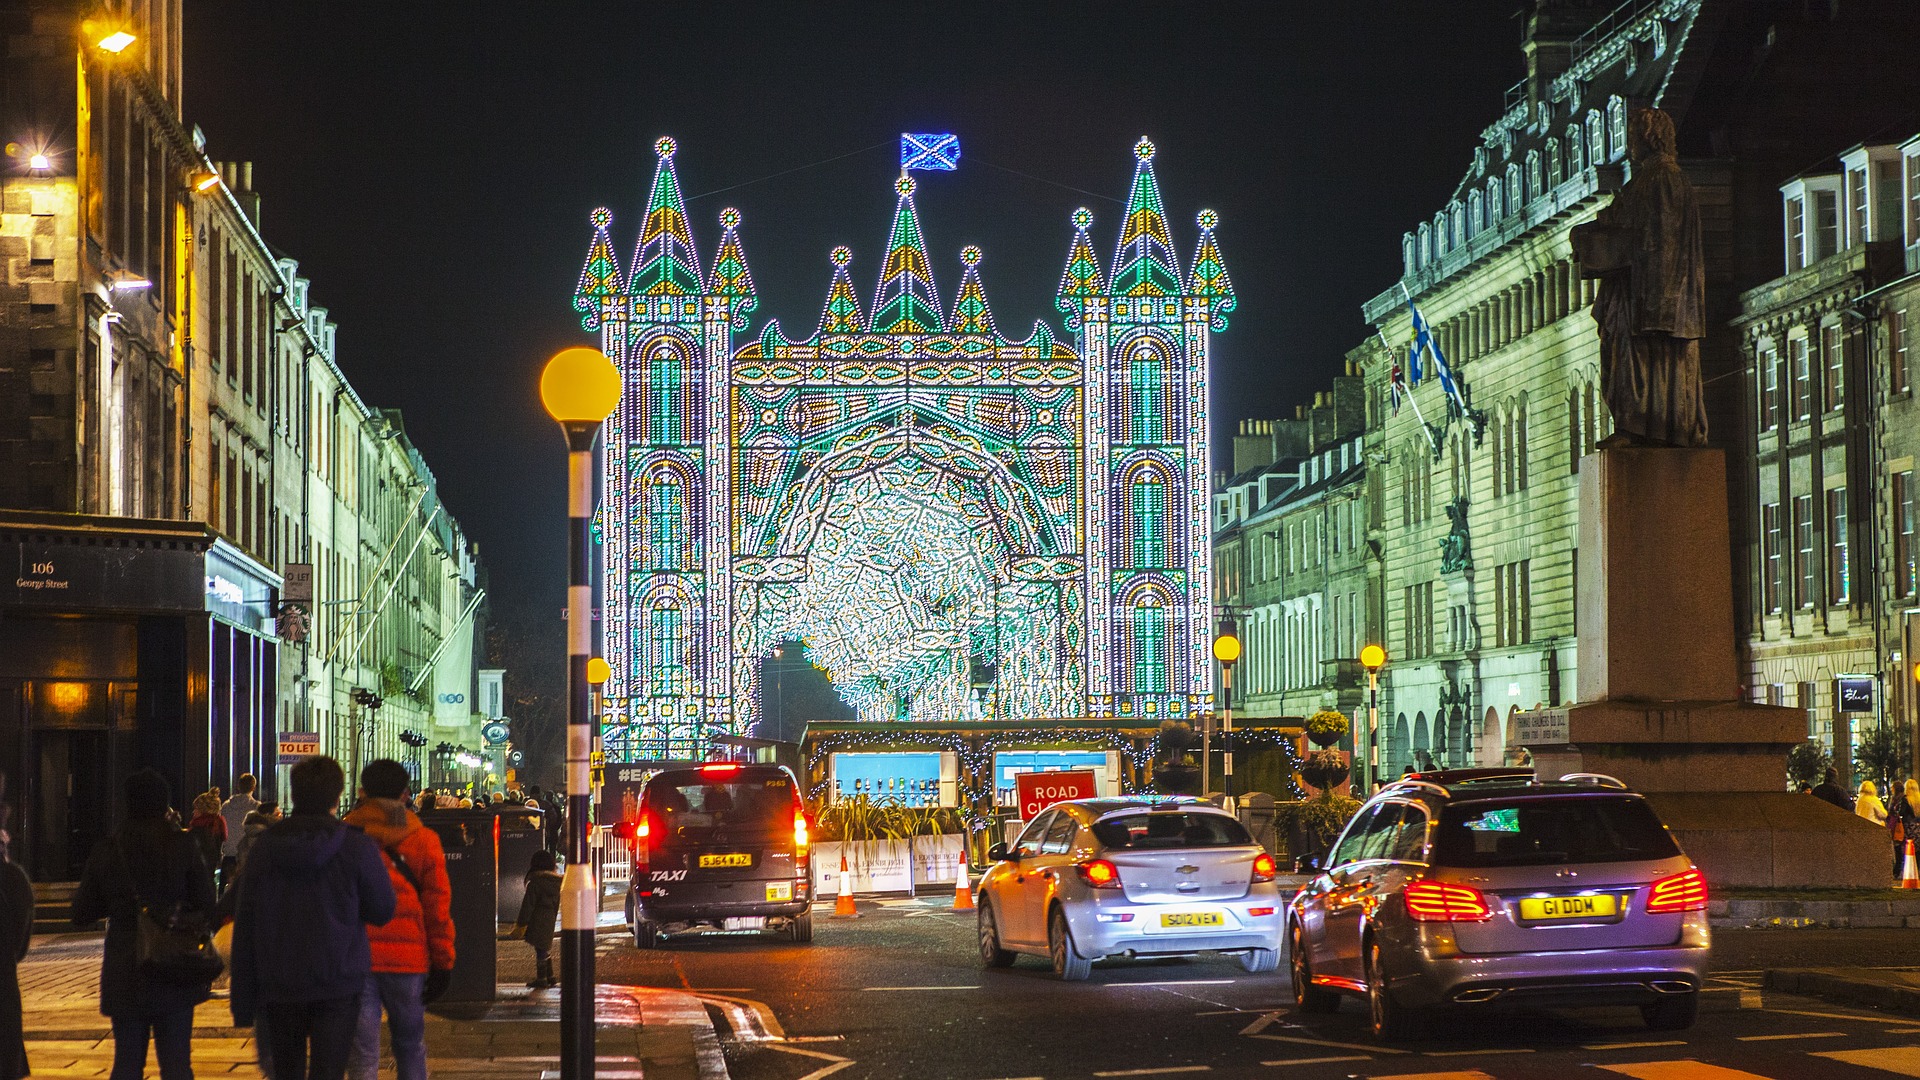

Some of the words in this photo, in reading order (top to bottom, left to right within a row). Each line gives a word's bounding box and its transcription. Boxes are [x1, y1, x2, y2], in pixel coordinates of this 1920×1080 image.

[32, 561, 54, 574] 106
[298, 573, 310, 582] LET
[16, 578, 45, 590] George
[45, 579, 69, 589] Street
[438, 693, 464, 704] TSB
[280, 744, 295, 753] TO
[297, 744, 316, 753] LET
[1035, 786, 1079, 799] ROAD
[703, 856, 727, 866] SJ64
[650, 870, 687, 882] TAXI
[1168, 914, 1194, 926] SD12
